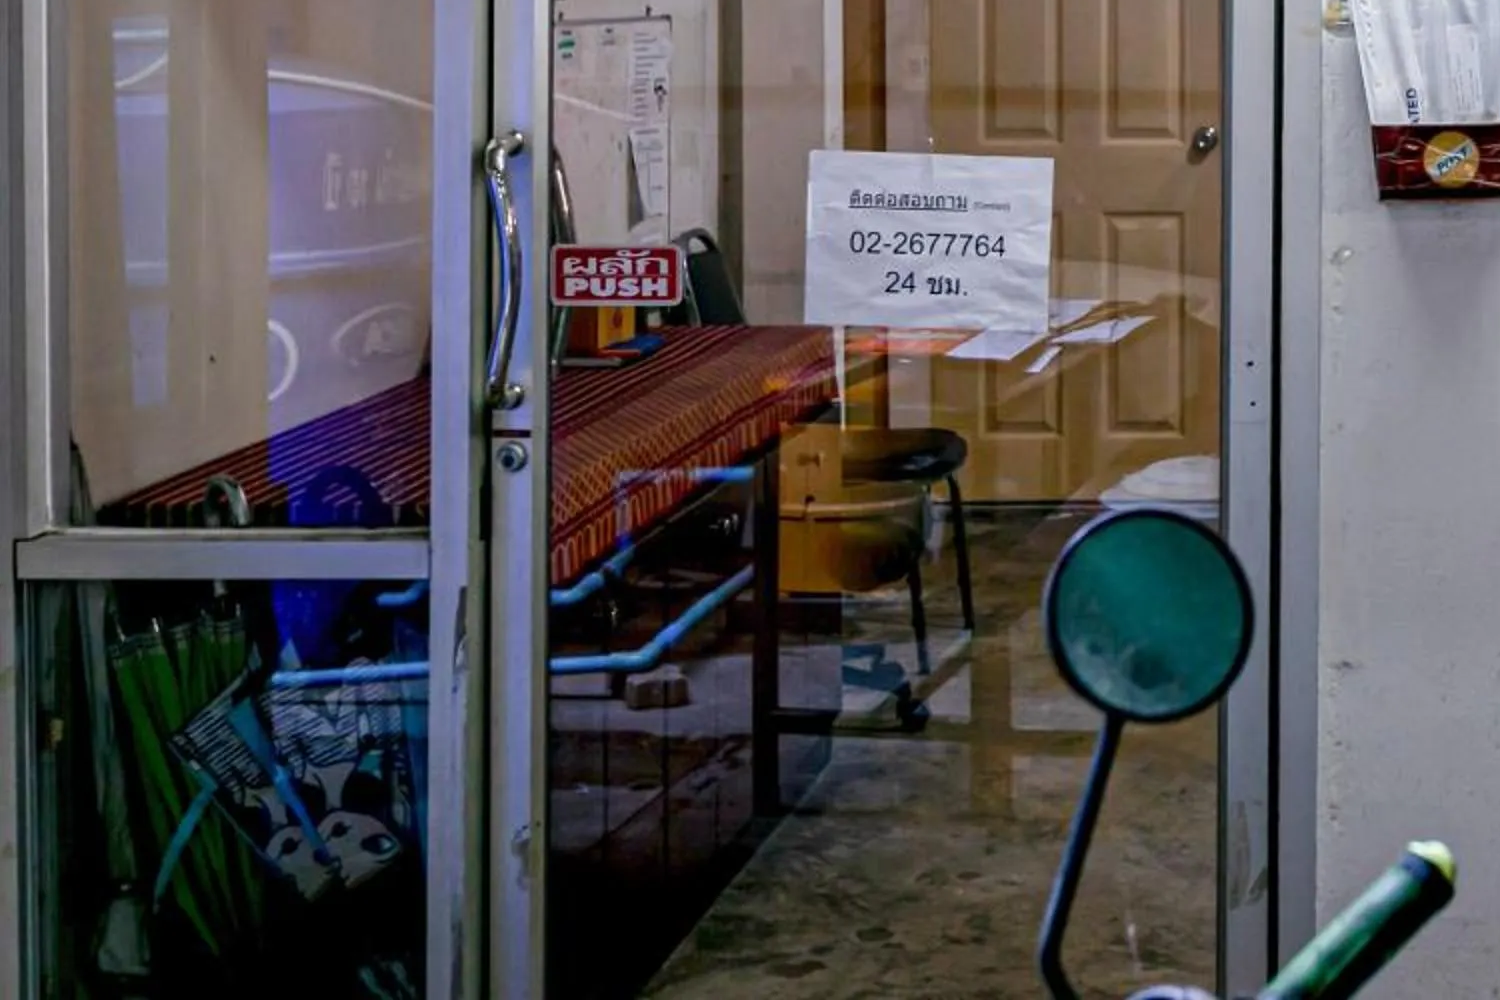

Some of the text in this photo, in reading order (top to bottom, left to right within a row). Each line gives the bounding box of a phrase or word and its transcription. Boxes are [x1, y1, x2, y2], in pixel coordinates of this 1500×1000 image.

[849, 229, 1007, 258] 02-2677764
[561, 248, 670, 276] ผลัก
[563, 277, 670, 298] PUSH
[884, 270, 969, 297] 24 ชม.
